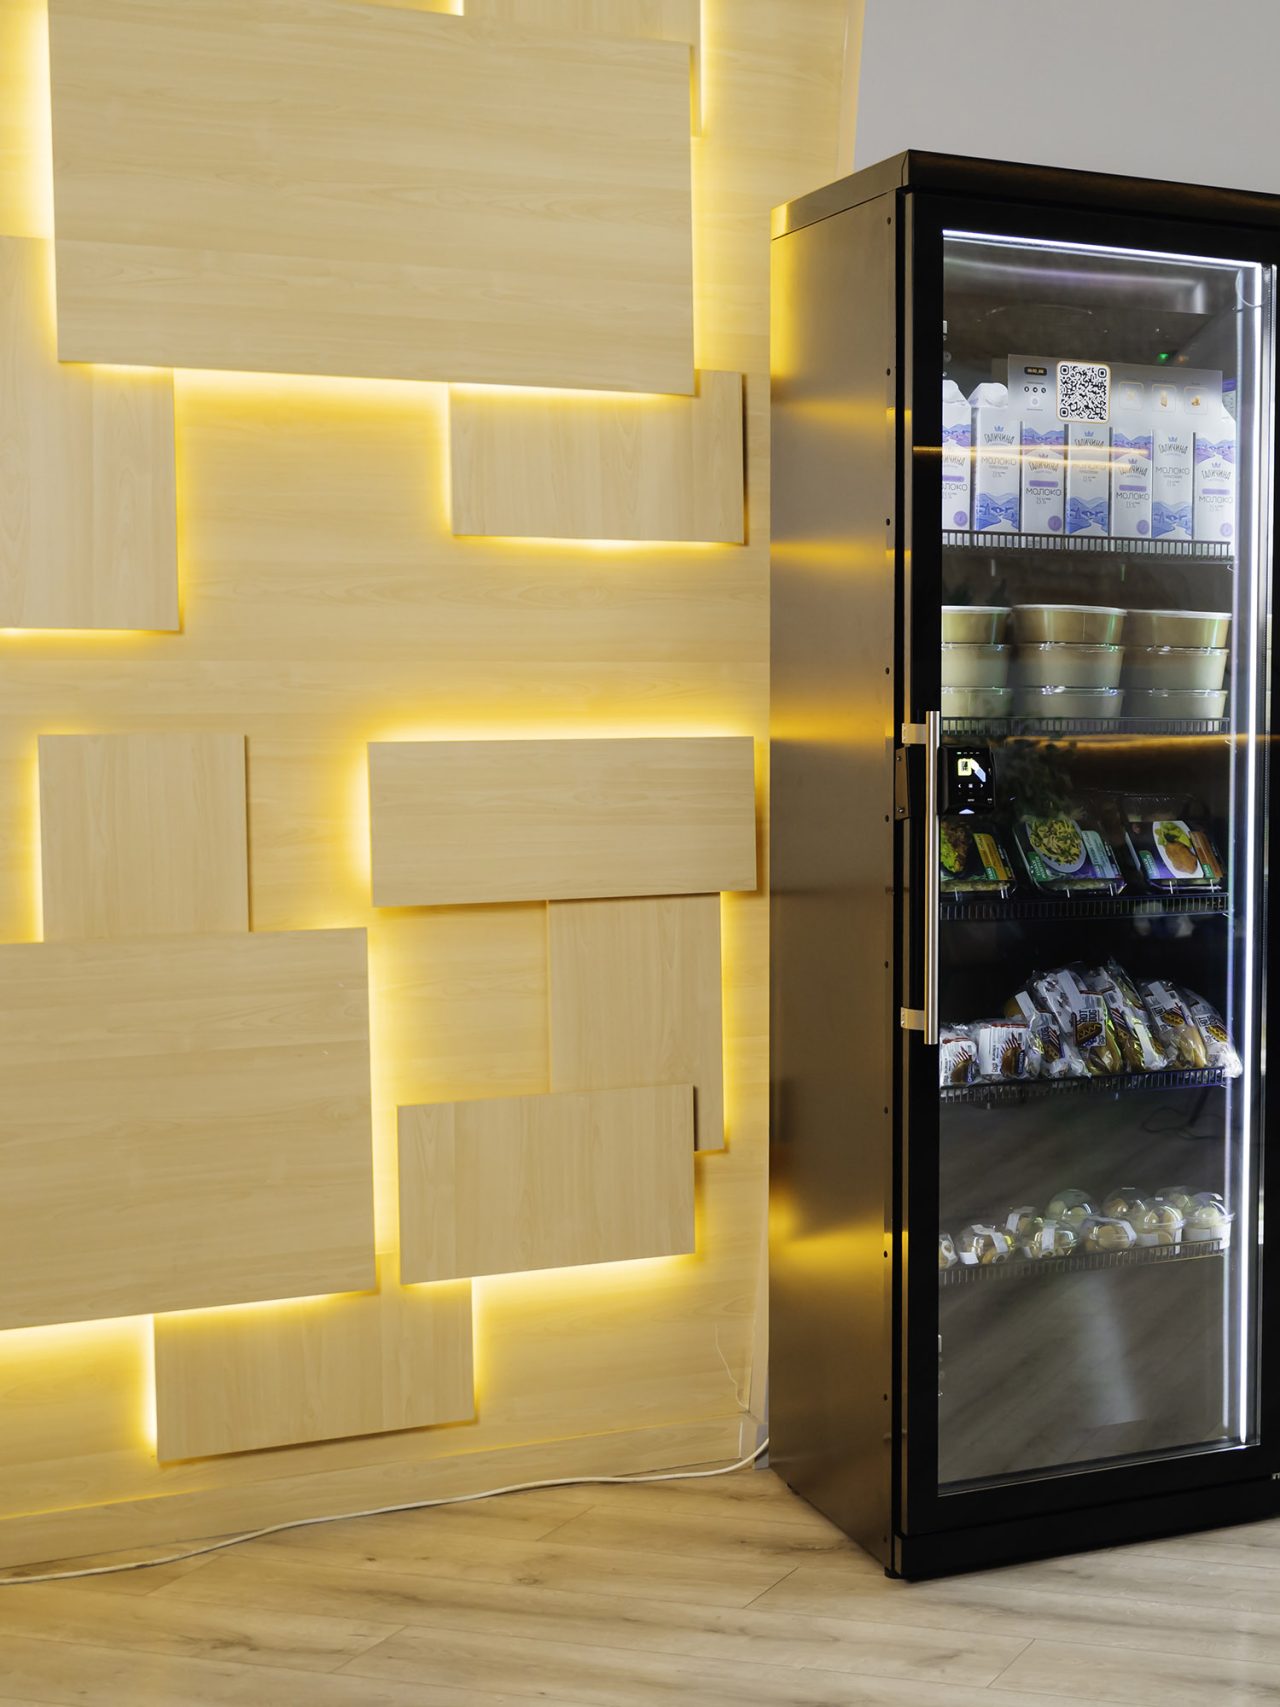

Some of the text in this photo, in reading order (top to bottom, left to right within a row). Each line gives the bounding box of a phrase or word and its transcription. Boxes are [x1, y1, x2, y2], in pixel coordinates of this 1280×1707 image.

[981, 457, 1017, 466] МОЛОКО
[1155, 466, 1190, 475] МОЛОКО
[1025, 488, 1062, 496] МОЛОКО
[1116, 492, 1150, 501] МОЛОКО
[1198, 496, 1234, 504] МОЛОКО
